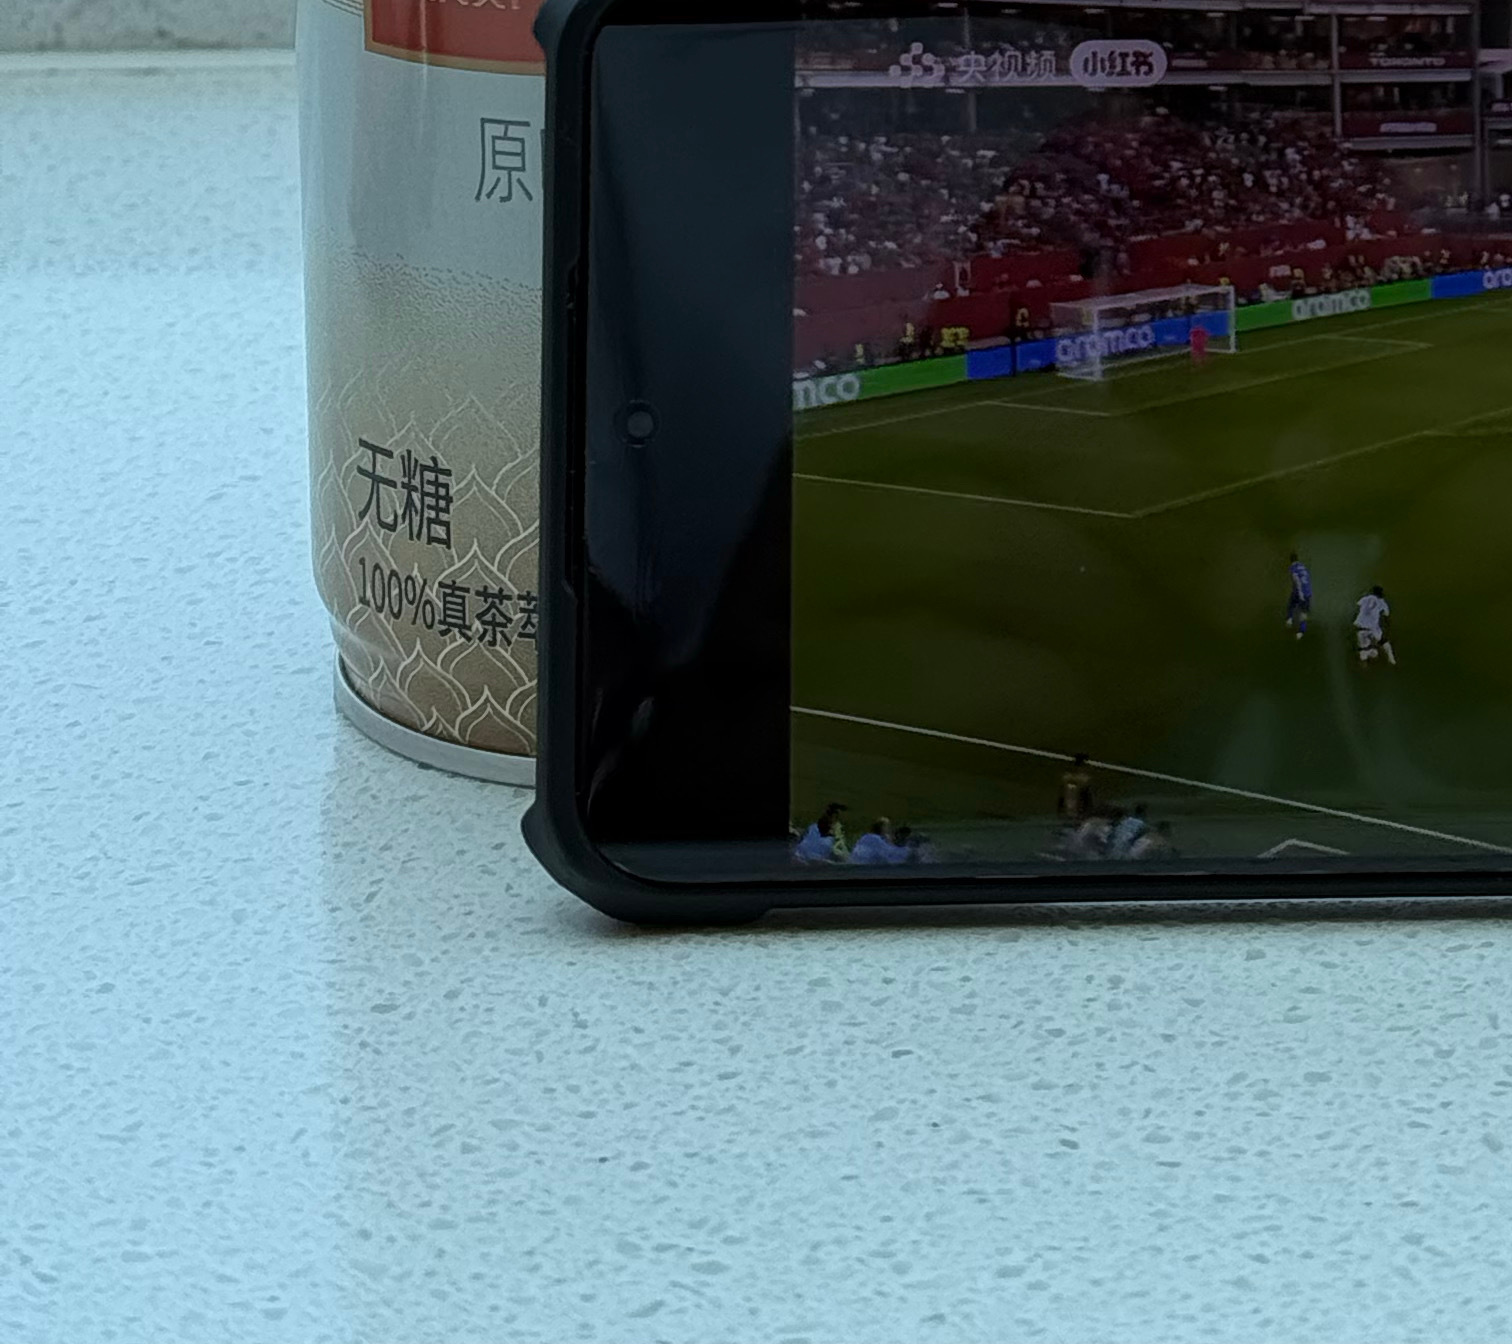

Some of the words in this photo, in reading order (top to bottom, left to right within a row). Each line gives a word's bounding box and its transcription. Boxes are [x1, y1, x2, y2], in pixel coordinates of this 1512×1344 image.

[958, 50, 1057, 82] 央视频
[1082, 51, 1156, 77] 小红书
[1291, 287, 1371, 321] aramco
[1055, 325, 1156, 363] aramco
[356, 436, 454, 550] 无糖
